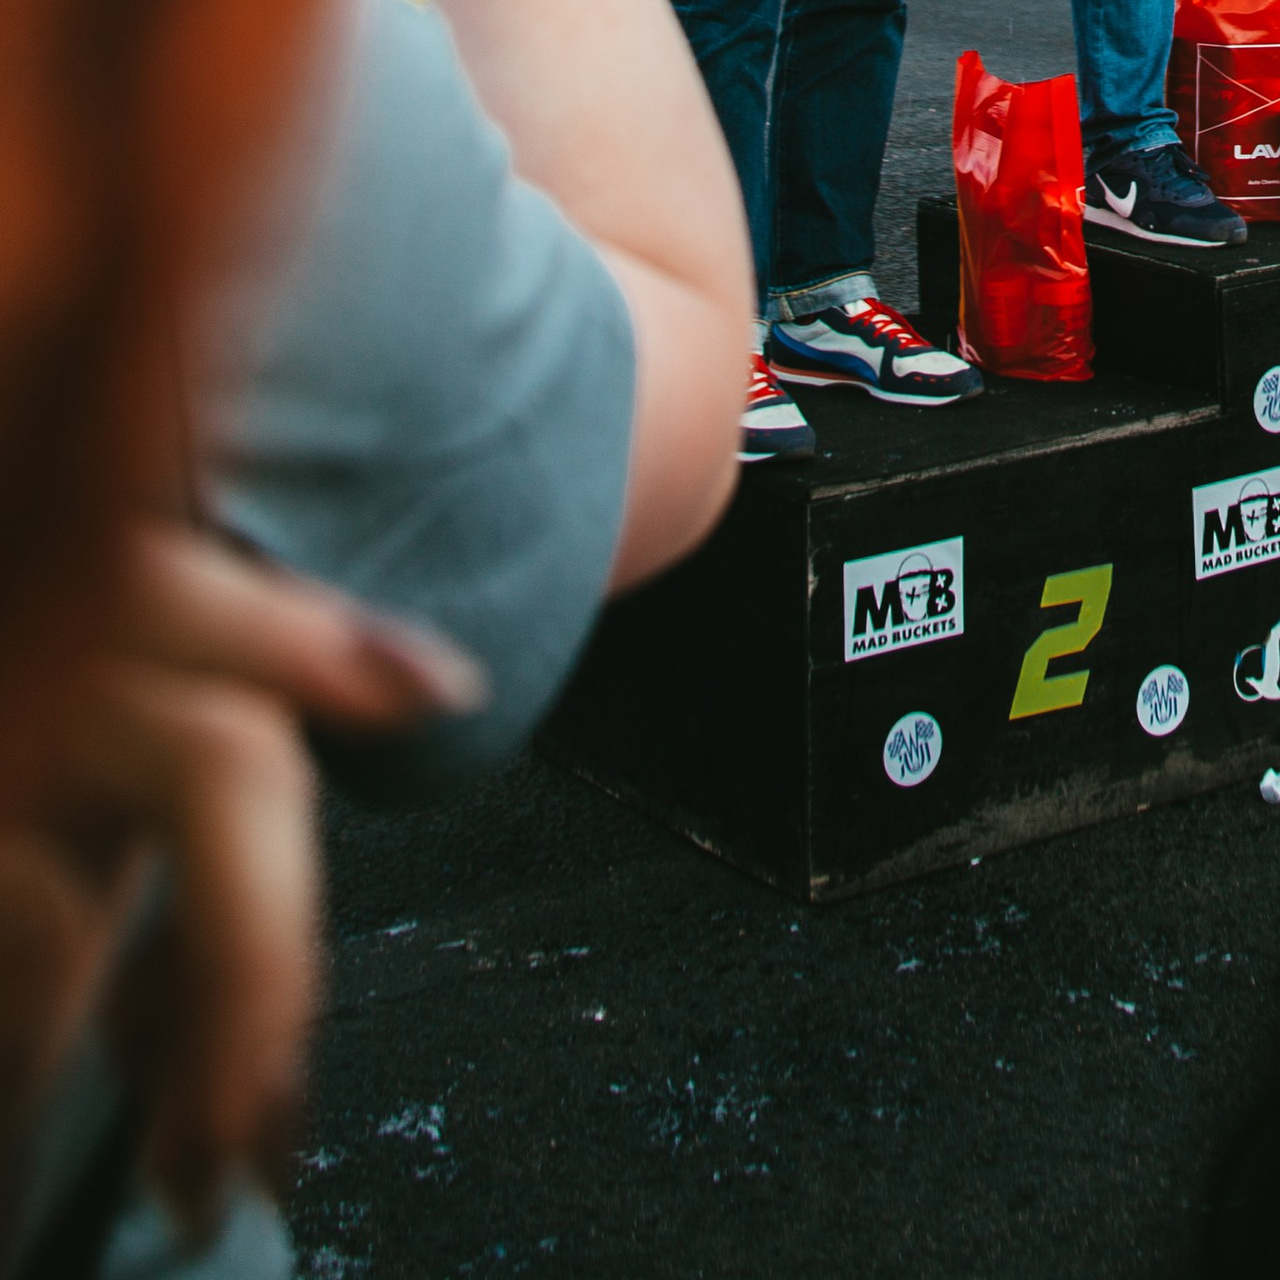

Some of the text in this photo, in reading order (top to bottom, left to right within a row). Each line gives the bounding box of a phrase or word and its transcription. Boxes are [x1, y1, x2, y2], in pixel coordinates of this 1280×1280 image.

[1201, 552, 1233, 573] MAD
[852, 617, 957, 655] MAD BUCKETS
[1008, 562, 1114, 721] 2
